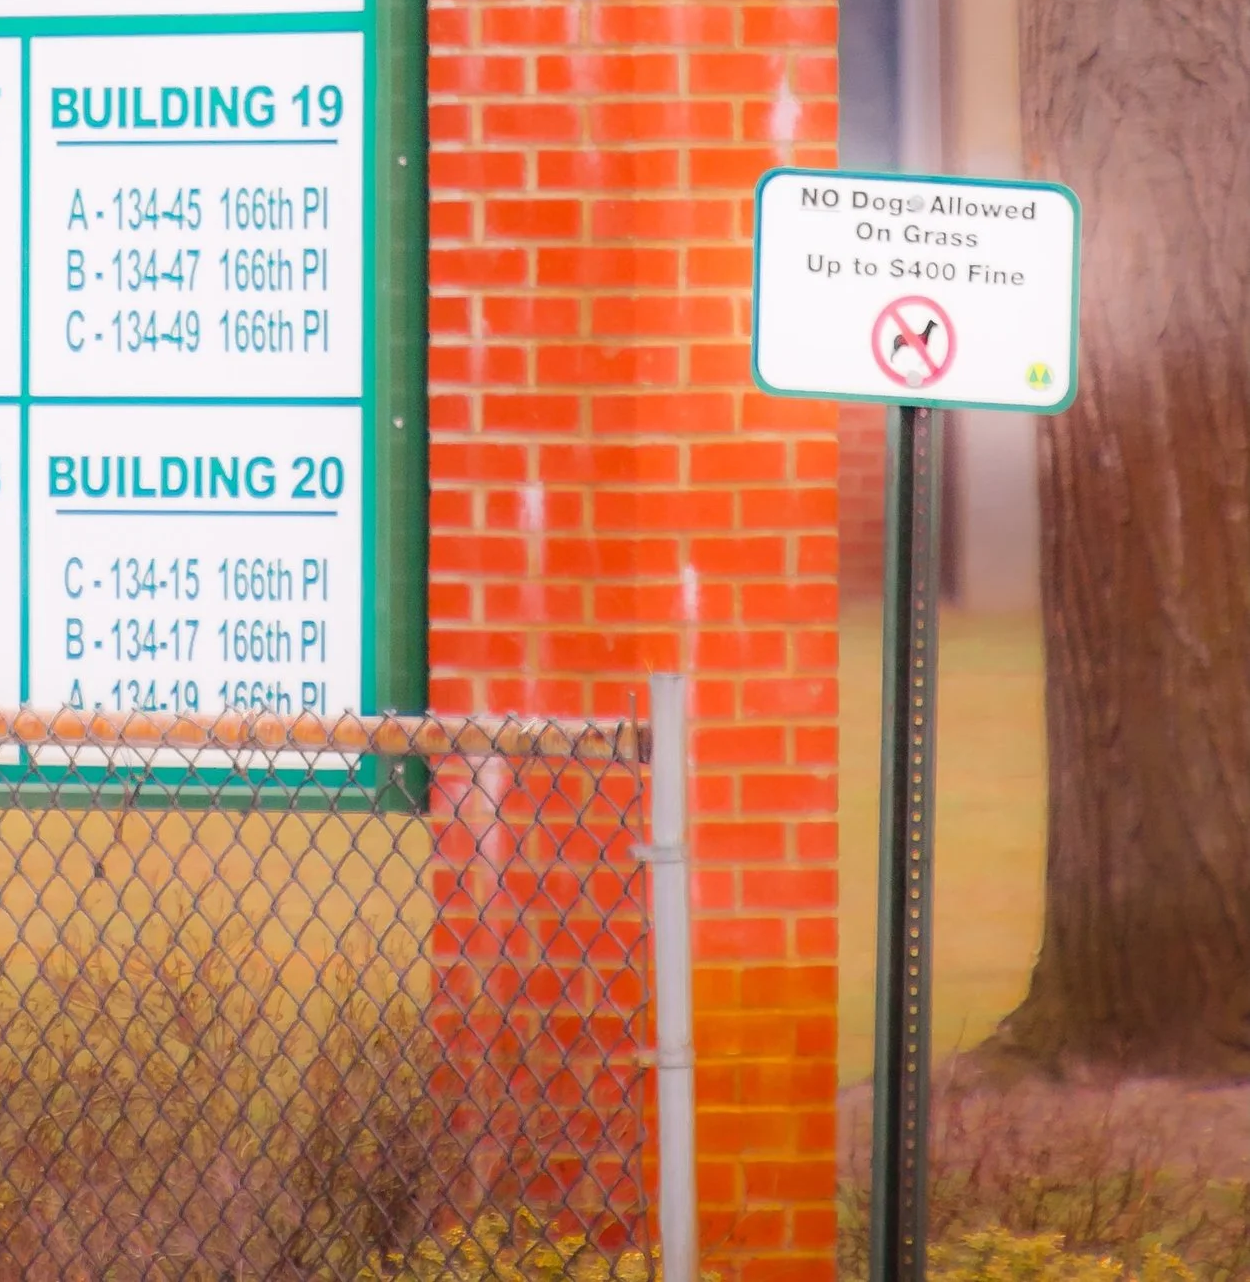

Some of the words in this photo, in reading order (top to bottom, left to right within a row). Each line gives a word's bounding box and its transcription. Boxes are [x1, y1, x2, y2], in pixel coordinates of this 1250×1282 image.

[50, 85, 276, 130] BUILDING
[291, 83, 344, 129] 19
[67, 188, 89, 230] A
[113, 188, 202, 230] 134-45
[220, 188, 294, 230] 166th
[303, 188, 328, 230] Pl
[801, 187, 840, 207] NO
[930, 195, 1037, 221] Allowed
[856, 221, 892, 243] On
[903, 224, 979, 248] Grass
[66, 248, 87, 292] B
[112, 248, 201, 292] 134-47
[219, 248, 293, 292] 166th
[302, 248, 328, 292] Pl
[807, 253, 842, 278] Up
[853, 258, 878, 277] to
[967, 264, 1026, 286] Fine
[65, 309, 86, 353] C
[112, 309, 201, 353] 134-49
[219, 309, 294, 353] 166th
[303, 309, 329, 353] Pl
[48, 455, 277, 500] BUILDING
[290, 455, 346, 500] 20
[63, 557, 84, 601] C
[110, 557, 200, 601] 134-15
[218, 557, 293, 601] 166th
[302, 557, 328, 601] Pl
[65, 617, 86, 662] B
[111, 617, 200, 662] 134-17
[218, 617, 292, 662] 166th
[300, 617, 326, 662] Pl
